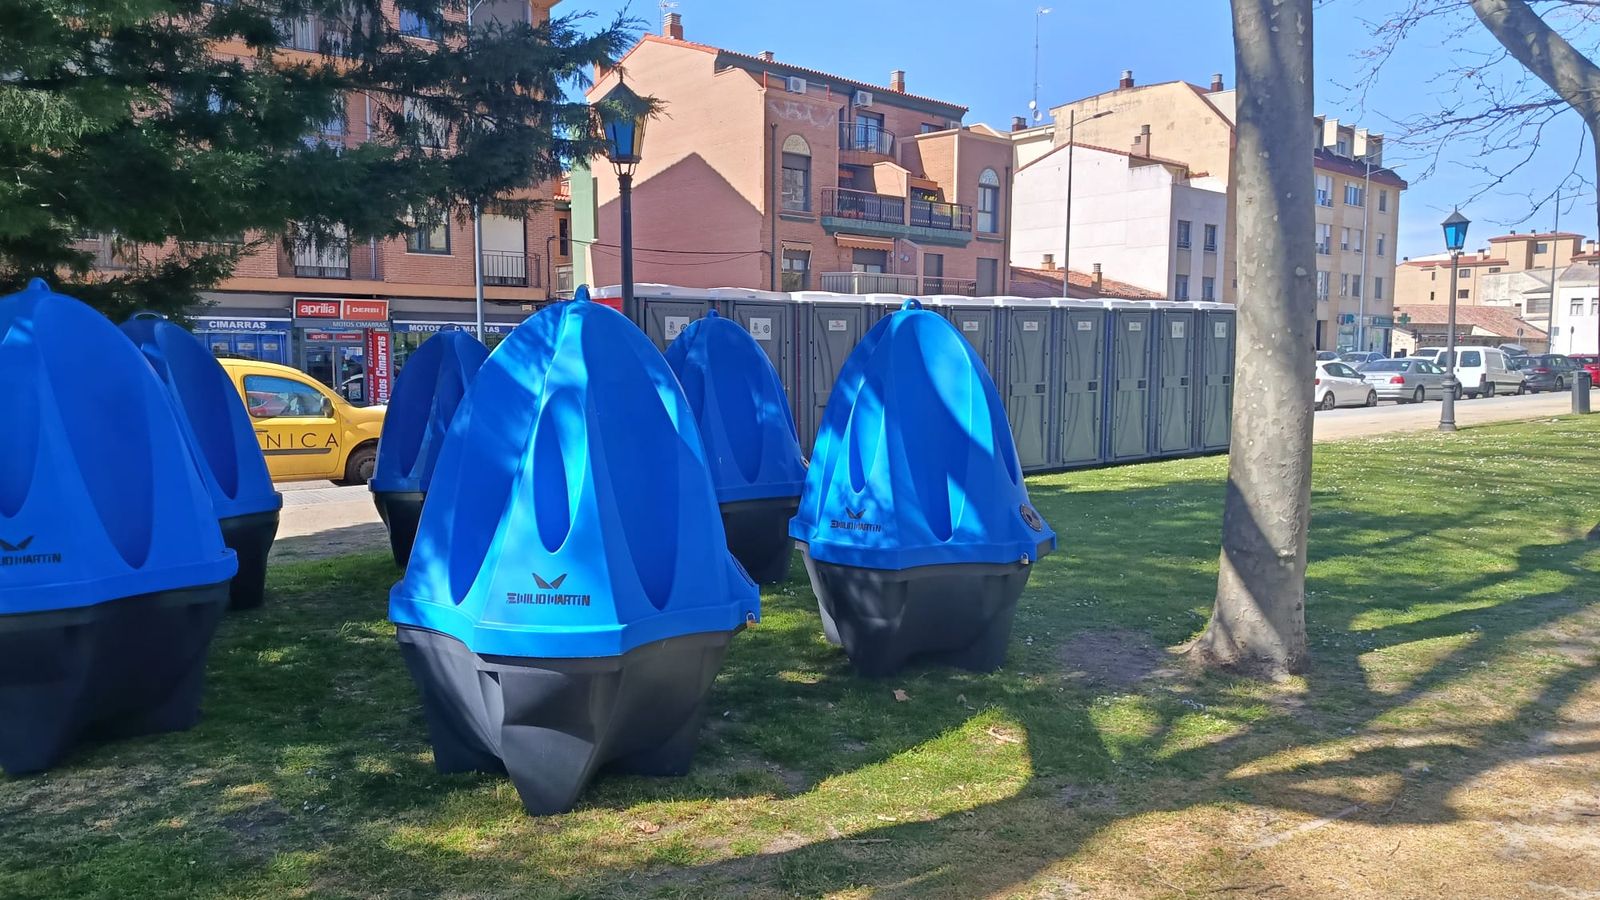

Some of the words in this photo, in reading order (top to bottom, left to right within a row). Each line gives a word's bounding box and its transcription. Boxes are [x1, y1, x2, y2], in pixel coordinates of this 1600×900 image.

[300, 303, 336, 315] aprilia
[208, 320, 267, 329] CIMARRAS
[408, 324, 440, 332] MOTOS
[454, 325, 500, 333] CMARAS
[375, 335, 387, 377] Cimarras
